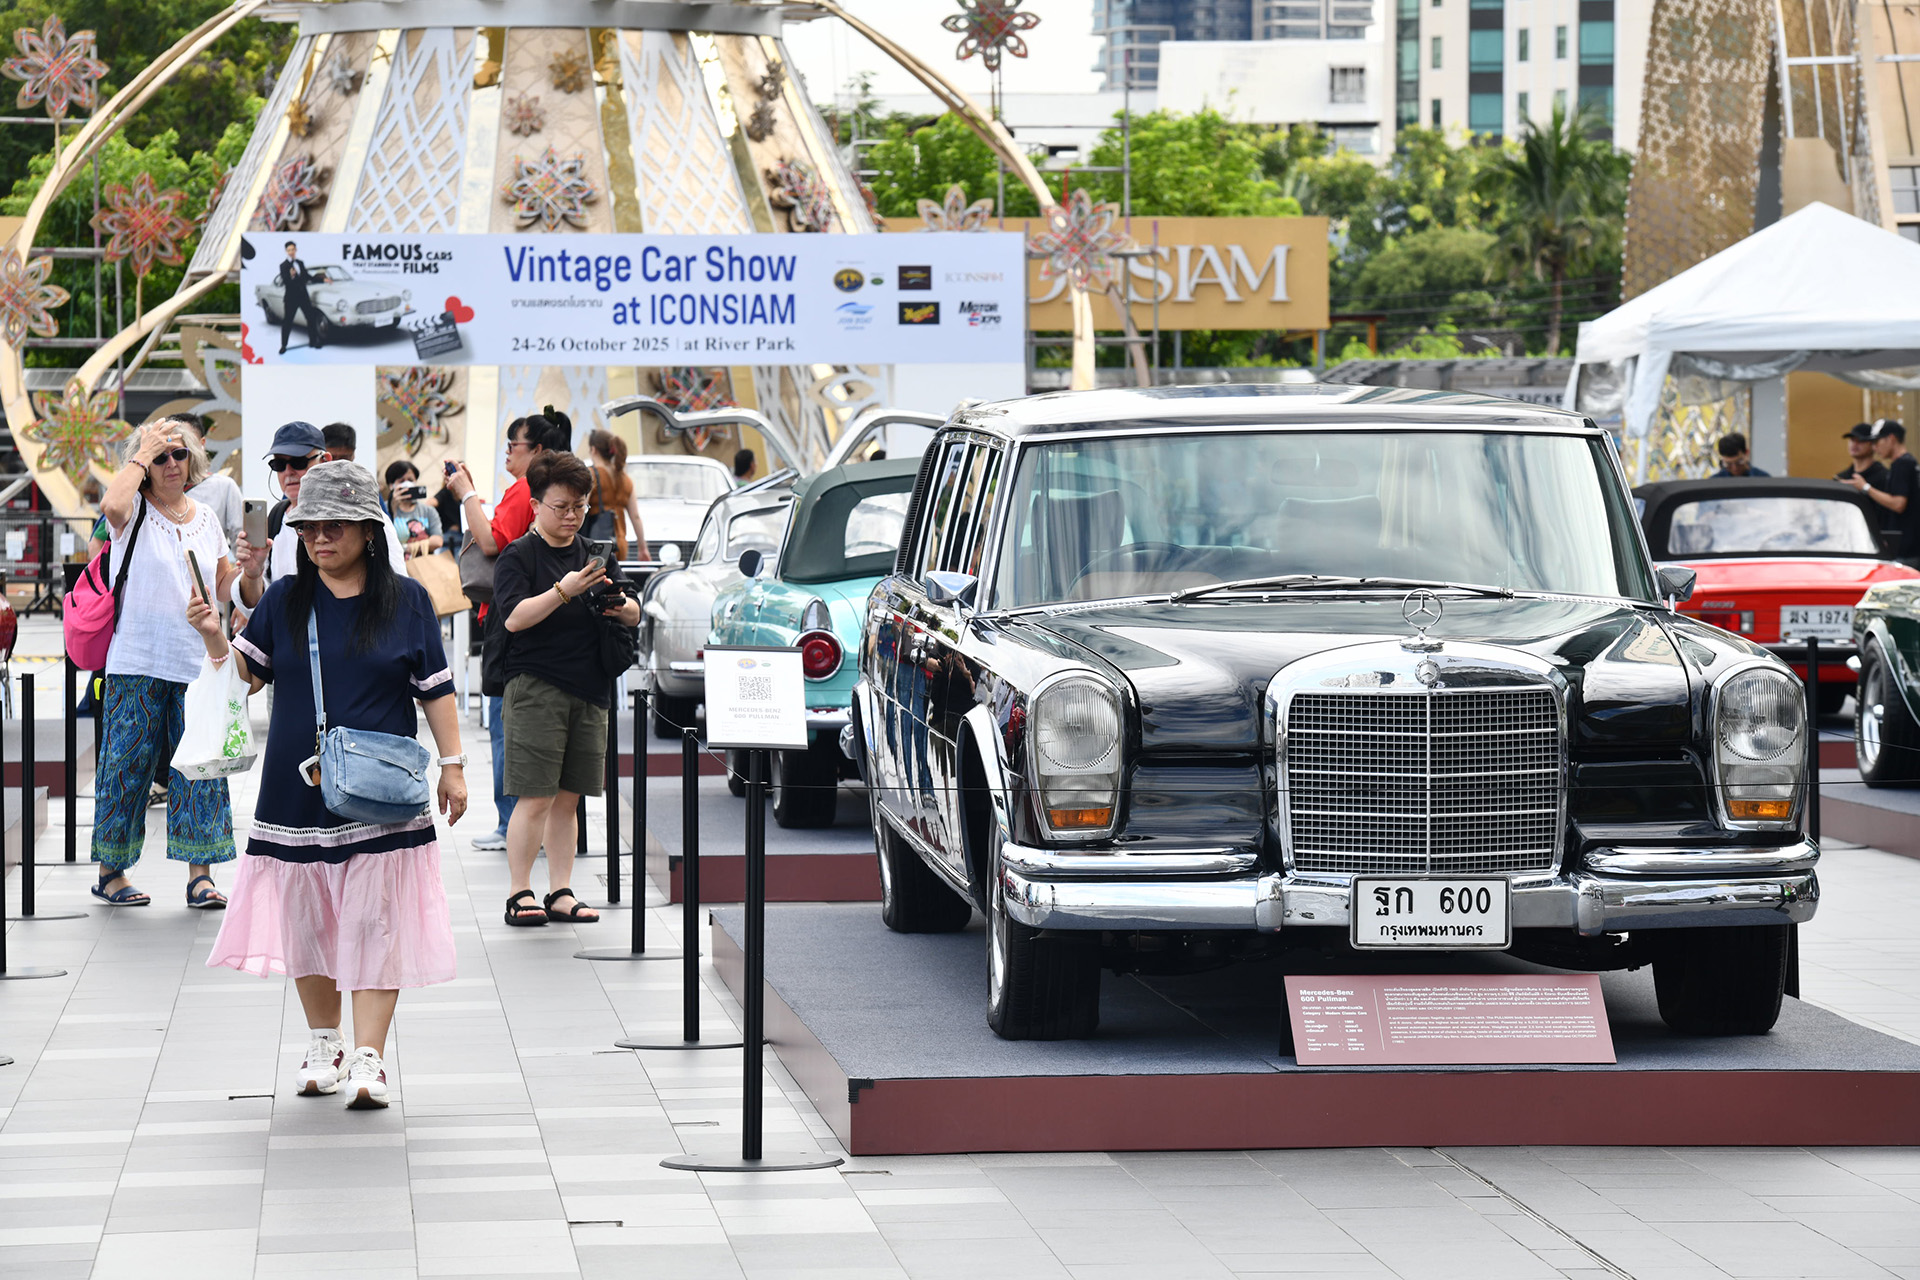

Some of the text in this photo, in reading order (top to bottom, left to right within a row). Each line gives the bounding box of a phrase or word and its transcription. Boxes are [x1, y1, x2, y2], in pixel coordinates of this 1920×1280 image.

[342, 244, 453, 260] FAMOUS CARS
[403, 262, 439, 274] FILMS
[504, 246, 796, 291] Vintage Car Show
[1030, 244, 1292, 303] SIAM
[612, 294, 796, 325] at ICONSIAM
[512, 336, 795, 351] 24-26 October 2025 at River Park
[1818, 610, 1848, 624] 1974
[1374, 886, 1490, 916] ฐก 600
[1380, 925, 1483, 940] กรุงเทพมหานคร
